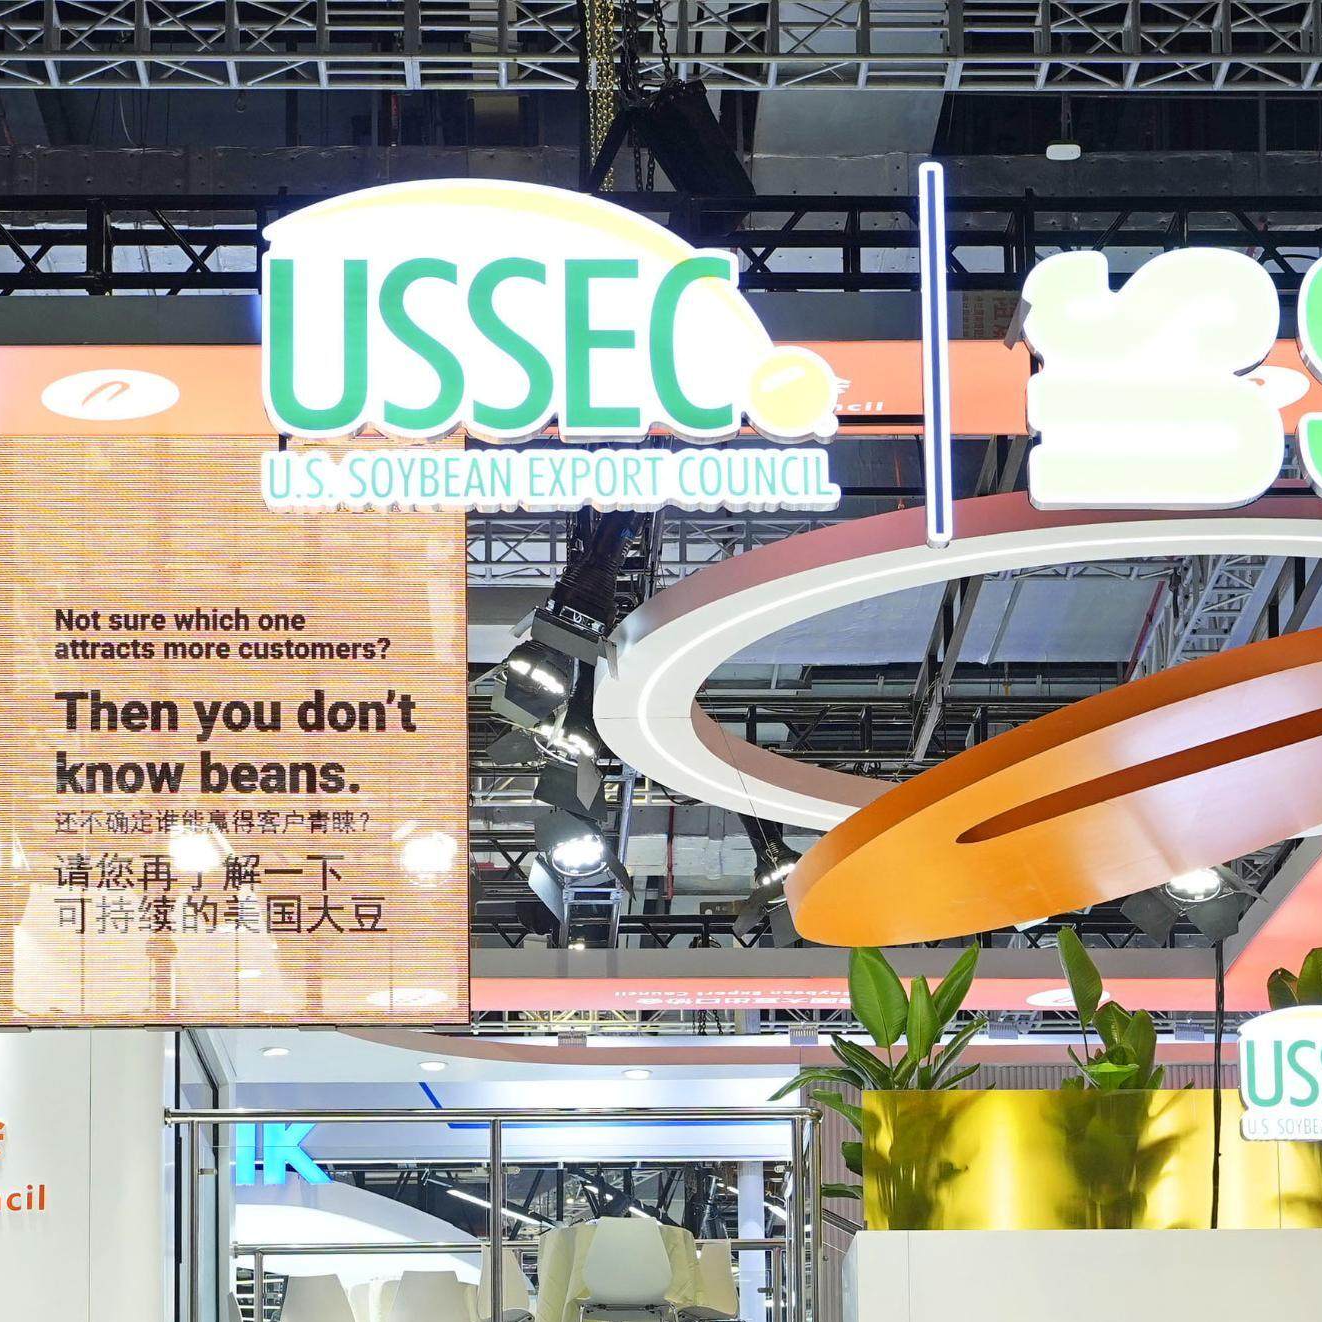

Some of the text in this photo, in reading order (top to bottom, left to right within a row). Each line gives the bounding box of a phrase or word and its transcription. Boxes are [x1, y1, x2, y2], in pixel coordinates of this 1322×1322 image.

[269, 256, 733, 431] USSEC
[269, 455, 834, 500] U.S. SOYBEAN EXPORT COUNCIL
[54, 608, 306, 632] Not sure which one
[54, 638, 391, 660] attracts more customers?
[54, 689, 417, 742] Then you don't
[54, 750, 361, 795] know beans.
[54, 894, 388, 935] 可持续的美国大豆
